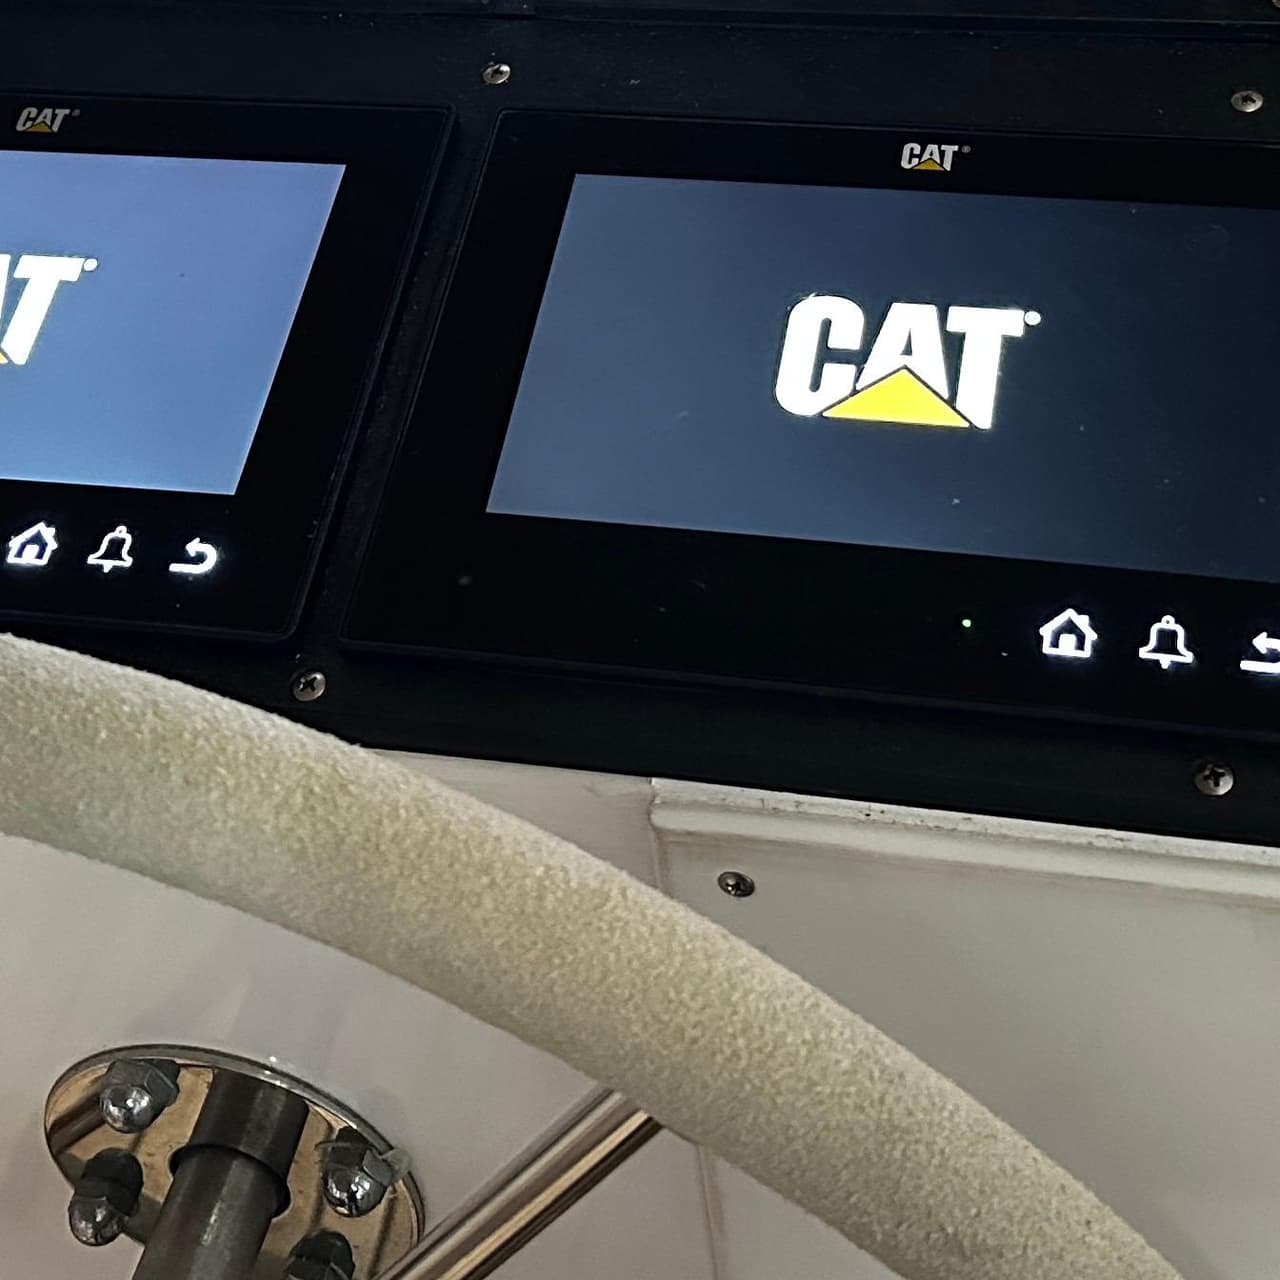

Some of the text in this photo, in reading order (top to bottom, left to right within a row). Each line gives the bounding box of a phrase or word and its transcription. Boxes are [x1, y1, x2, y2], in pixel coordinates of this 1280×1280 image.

[16, 107, 71, 133] CAT
[901, 142, 959, 172] CAT
[775, 294, 1026, 430] CAT
